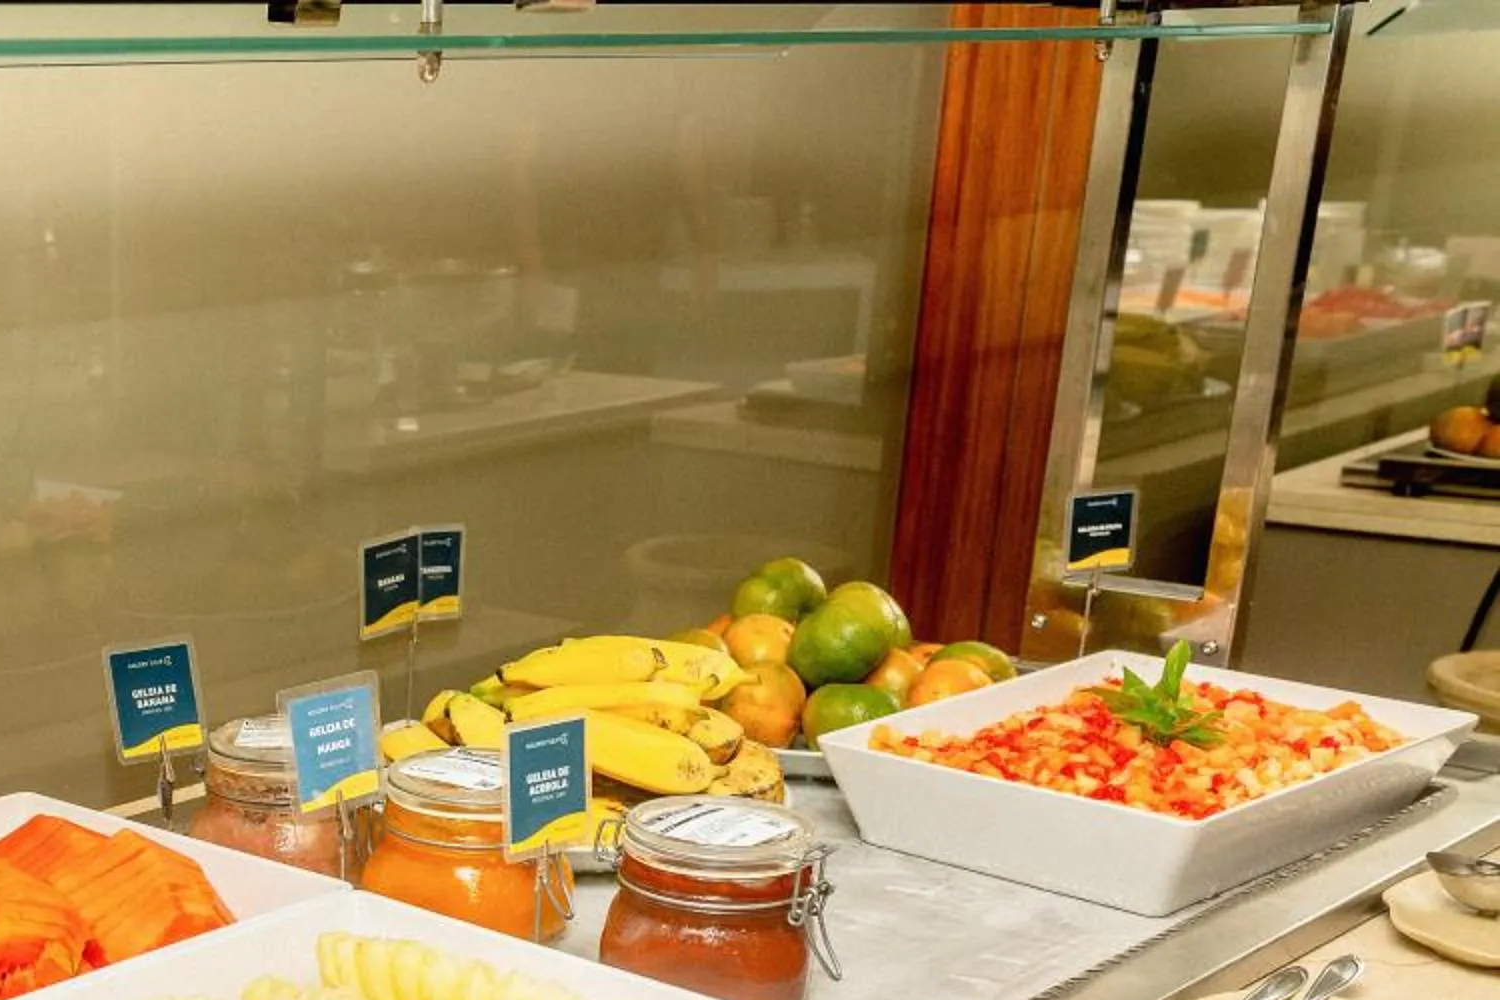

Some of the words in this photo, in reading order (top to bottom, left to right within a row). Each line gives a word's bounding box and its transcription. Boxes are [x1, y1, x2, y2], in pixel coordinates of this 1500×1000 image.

[131, 685, 164, 699] GELEIA
[166, 683, 178, 694] DE
[136, 695, 176, 710] BANANA
[317, 738, 352, 756] MANGA
[526, 769, 557, 785] GELEIA
[558, 765, 571, 778] DE
[529, 779, 569, 797] ACEROLA
